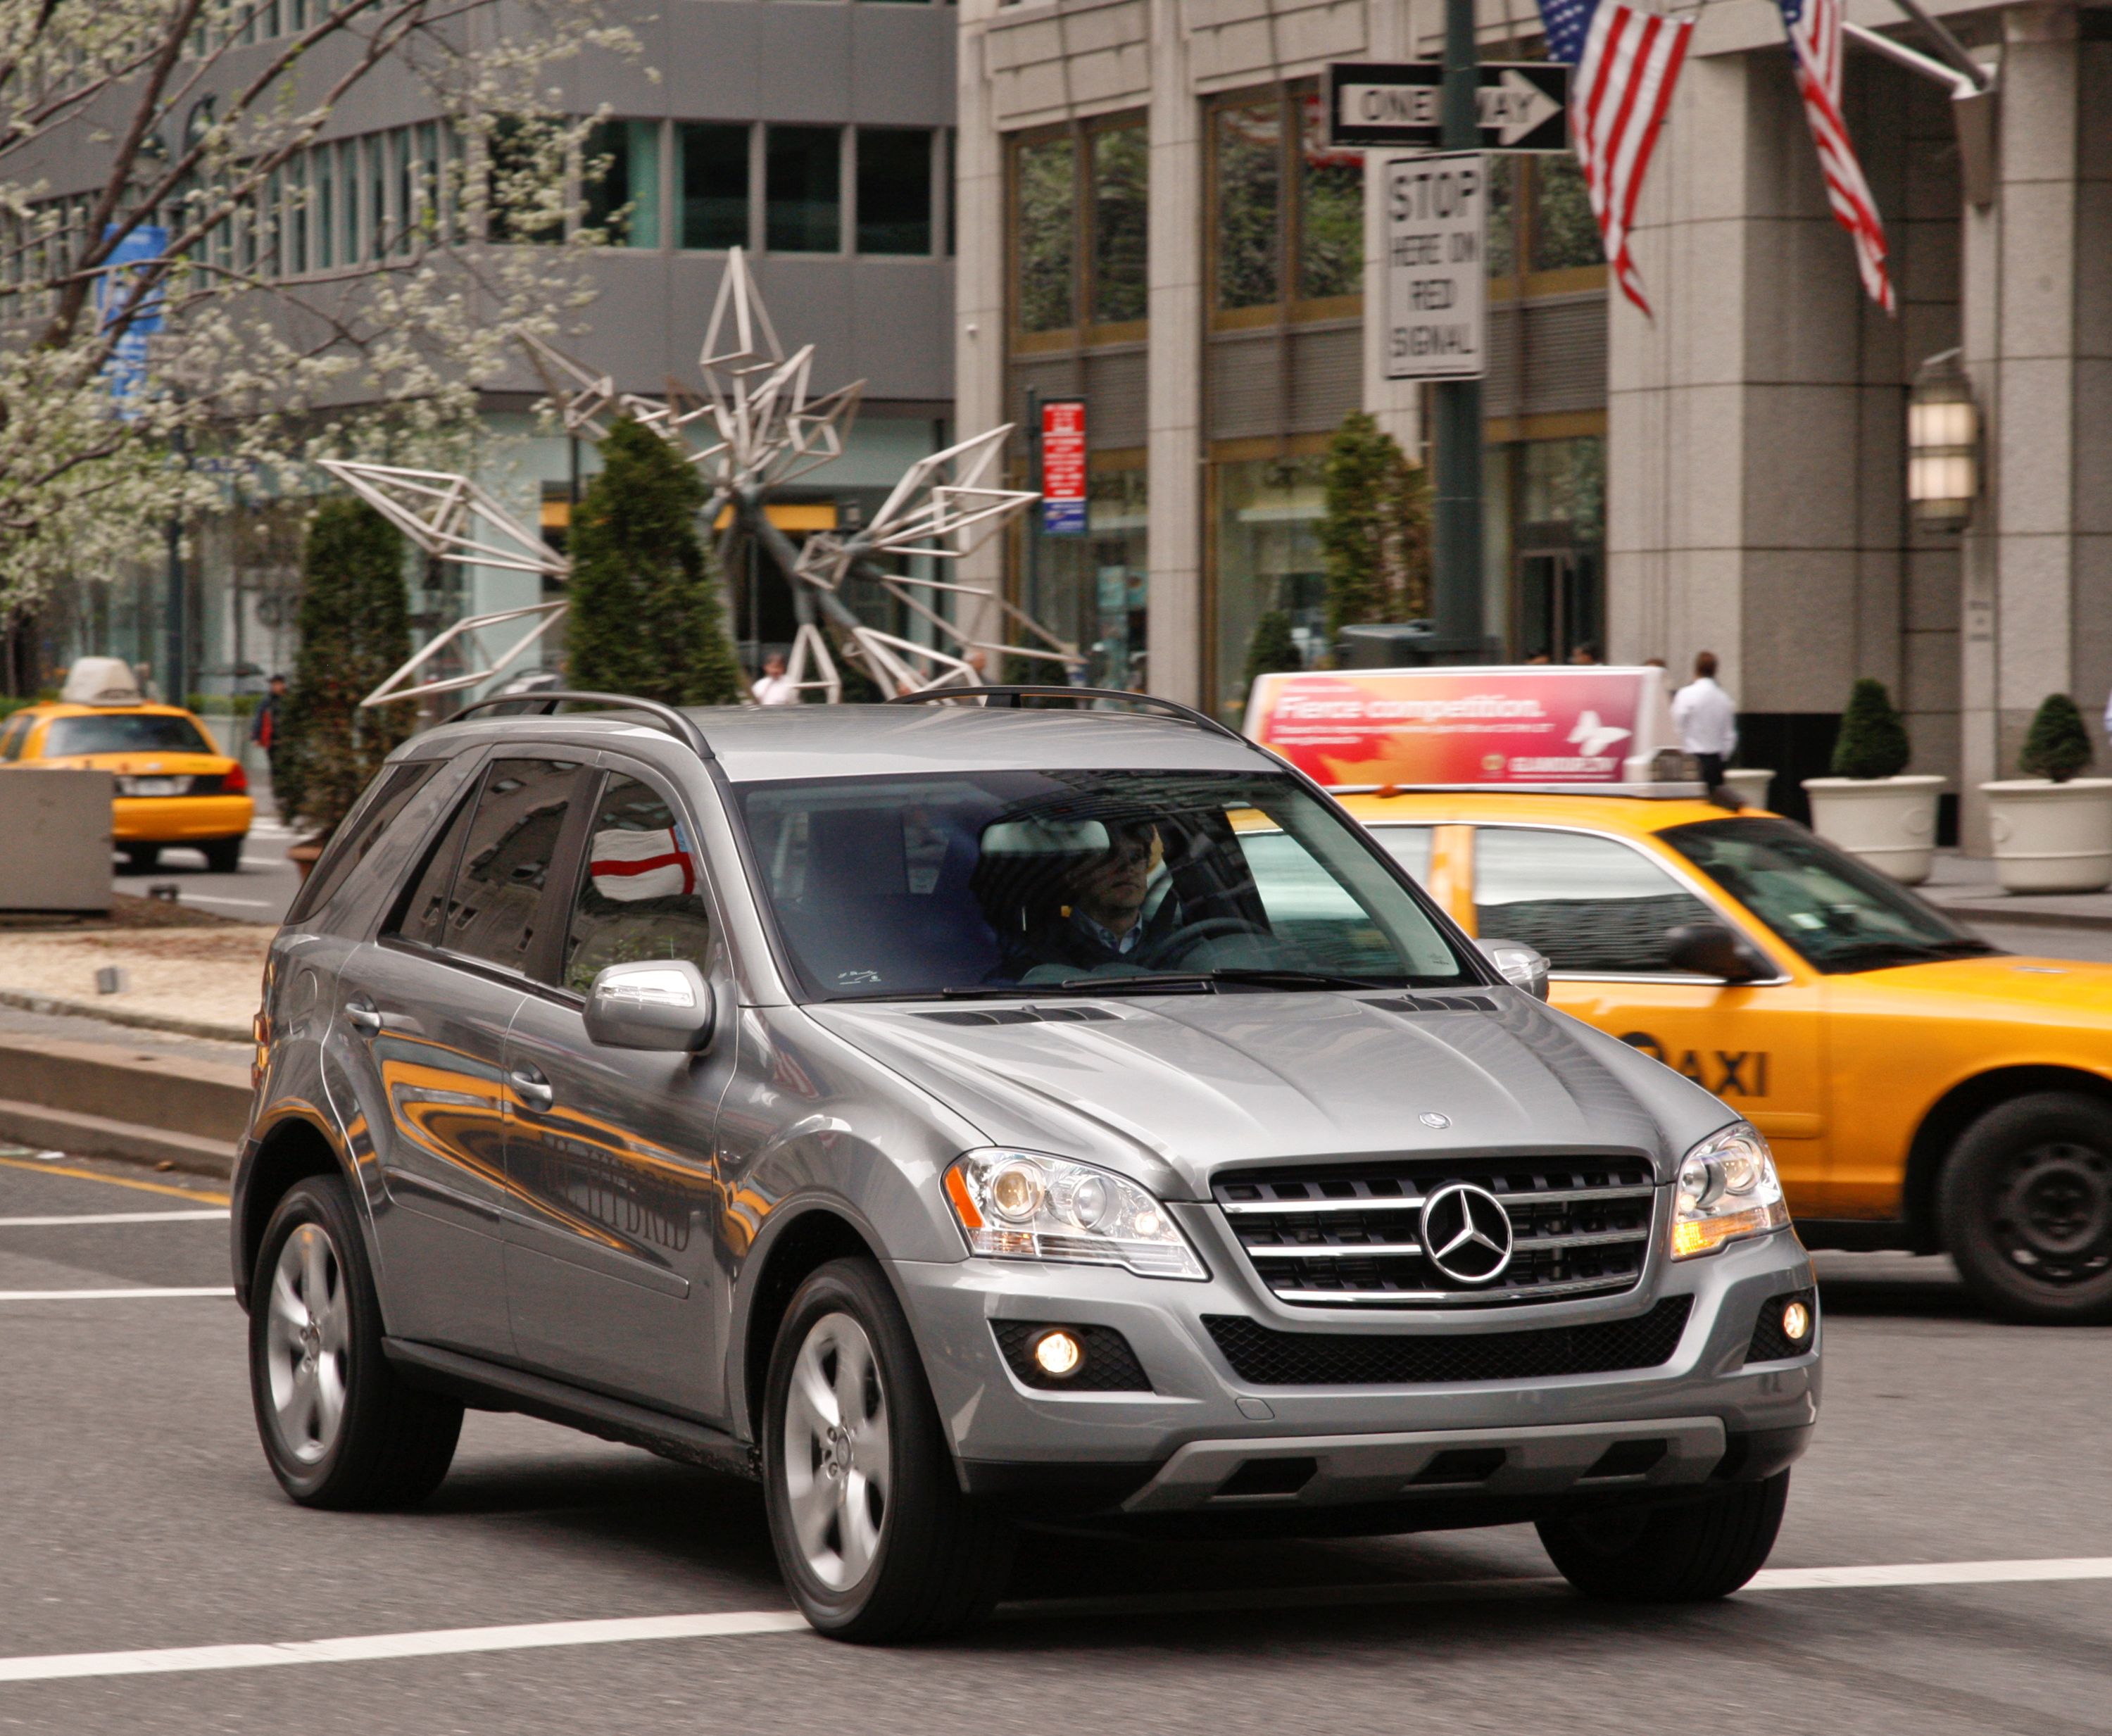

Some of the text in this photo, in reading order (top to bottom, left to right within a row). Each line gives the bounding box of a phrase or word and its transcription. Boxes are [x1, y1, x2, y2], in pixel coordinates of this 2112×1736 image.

[1360, 89, 1538, 123] ONE AY
[1392, 170, 1478, 222] STOP
[1391, 233, 1442, 267] HERE
[1410, 279, 1458, 310] RED
[1391, 324, 1476, 358] SIGNAL
[1274, 696, 1363, 719] Fierce
